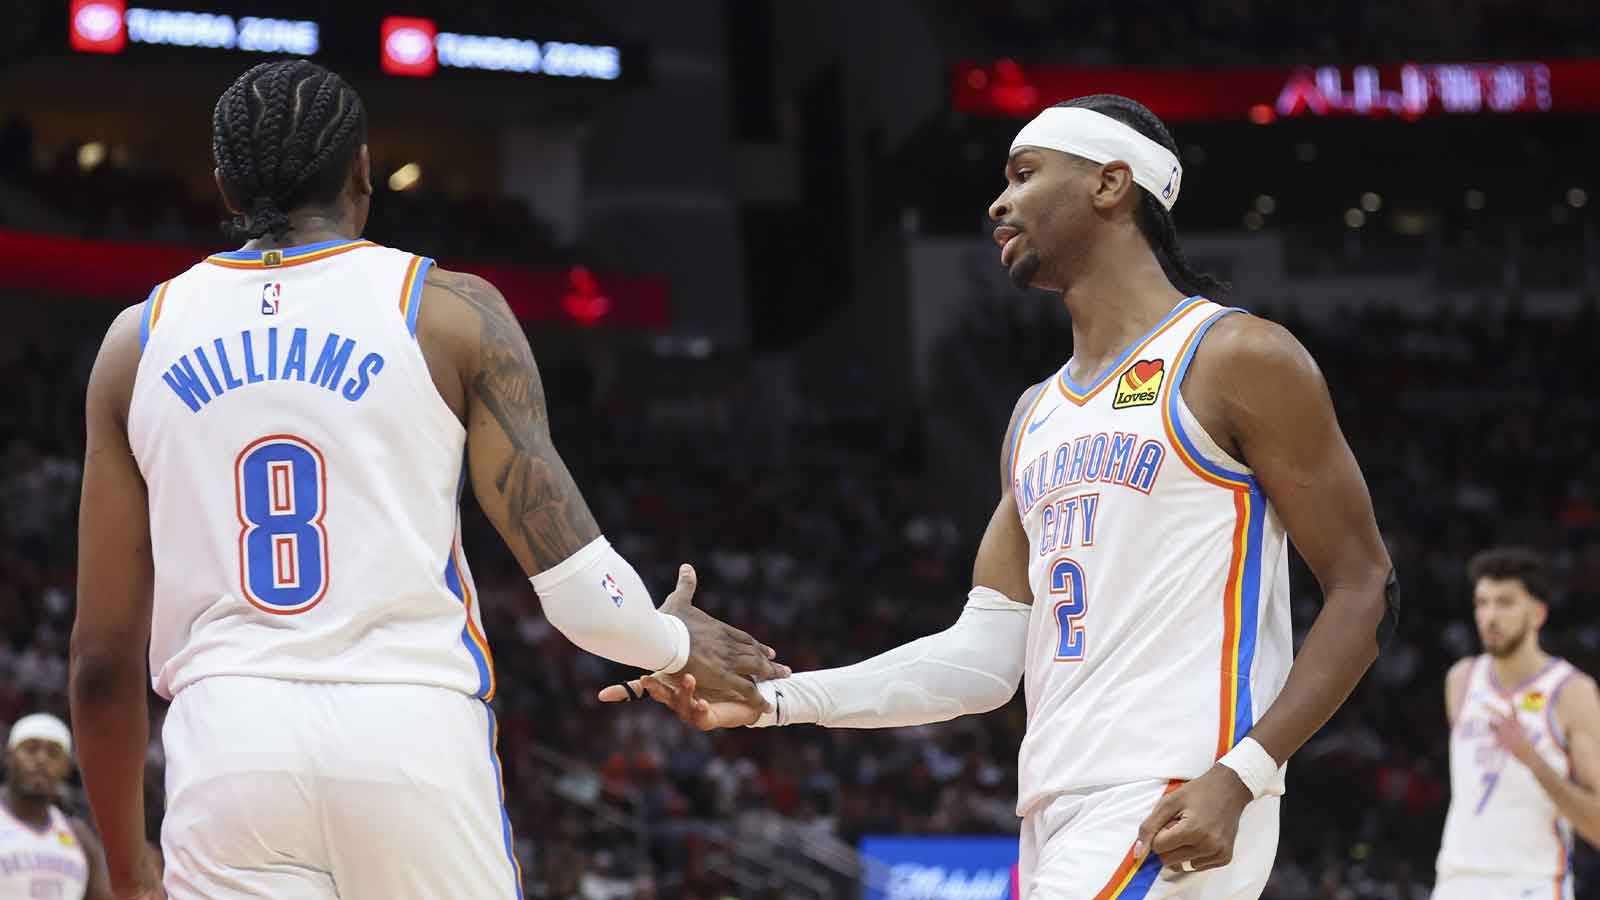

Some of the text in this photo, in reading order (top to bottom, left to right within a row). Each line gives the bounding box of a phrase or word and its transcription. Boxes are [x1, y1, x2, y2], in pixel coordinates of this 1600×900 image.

[162, 327, 385, 413] WILLIAMS
[235, 434, 330, 615] 8
[1040, 493, 1100, 556] CITY
[1050, 557, 1088, 662] 2
[1475, 771, 1500, 816] 7
